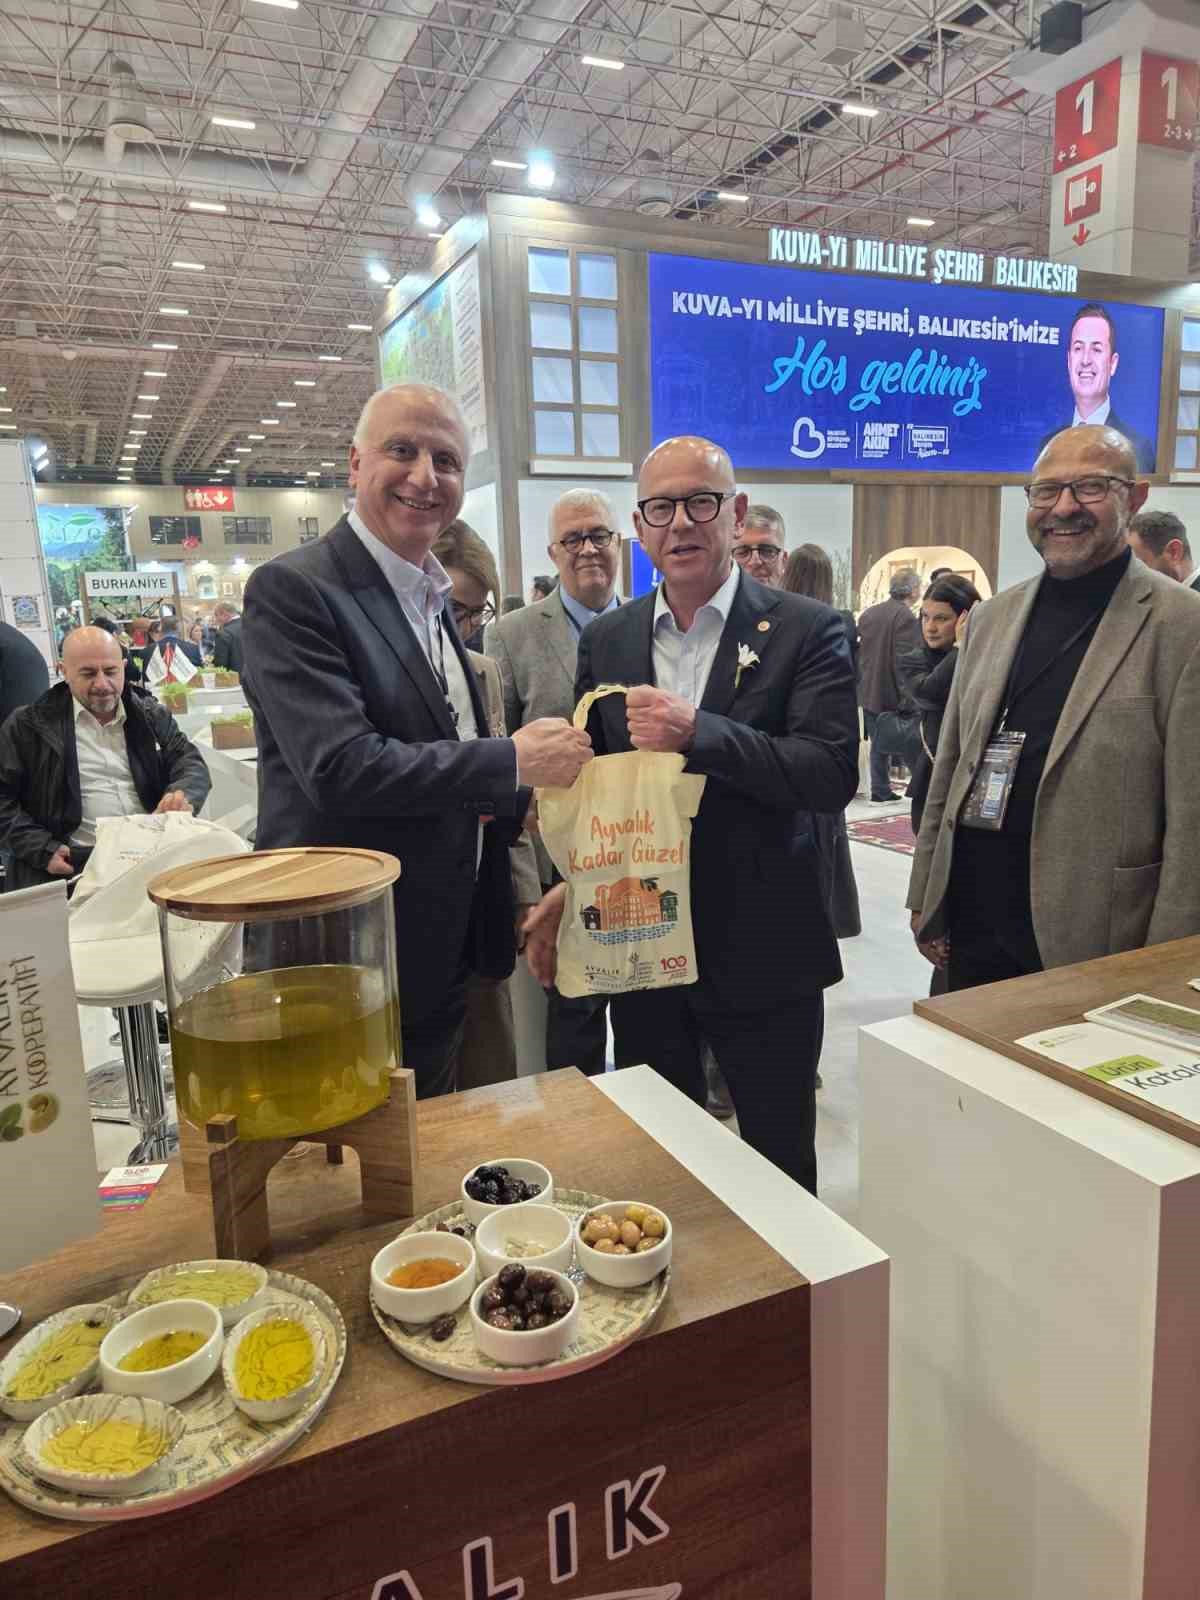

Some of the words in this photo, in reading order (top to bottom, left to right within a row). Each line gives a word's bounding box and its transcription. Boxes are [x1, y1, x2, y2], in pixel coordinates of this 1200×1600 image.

[1075, 80, 1095, 135] 1
[1161, 67, 1178, 120] 1
[1070, 144, 1077, 158] 2
[855, 239, 928, 276] MİLLİYE
[933, 249, 984, 284] ŞEHRİ
[995, 256, 1078, 292] BALIKESİR
[672, 291, 763, 321] KUVA-YI
[767, 296, 849, 328] MİLLİYE
[853, 307, 915, 337] ŞEHRİ,
[850, 348, 988, 416] geldiniz
[91, 576, 168, 590] BURHANİYE
[590, 808, 655, 846] Ayvalık
[567, 842, 625, 874] Kadar
[631, 837, 684, 864] Güzel
[660, 955, 688, 970] 100
